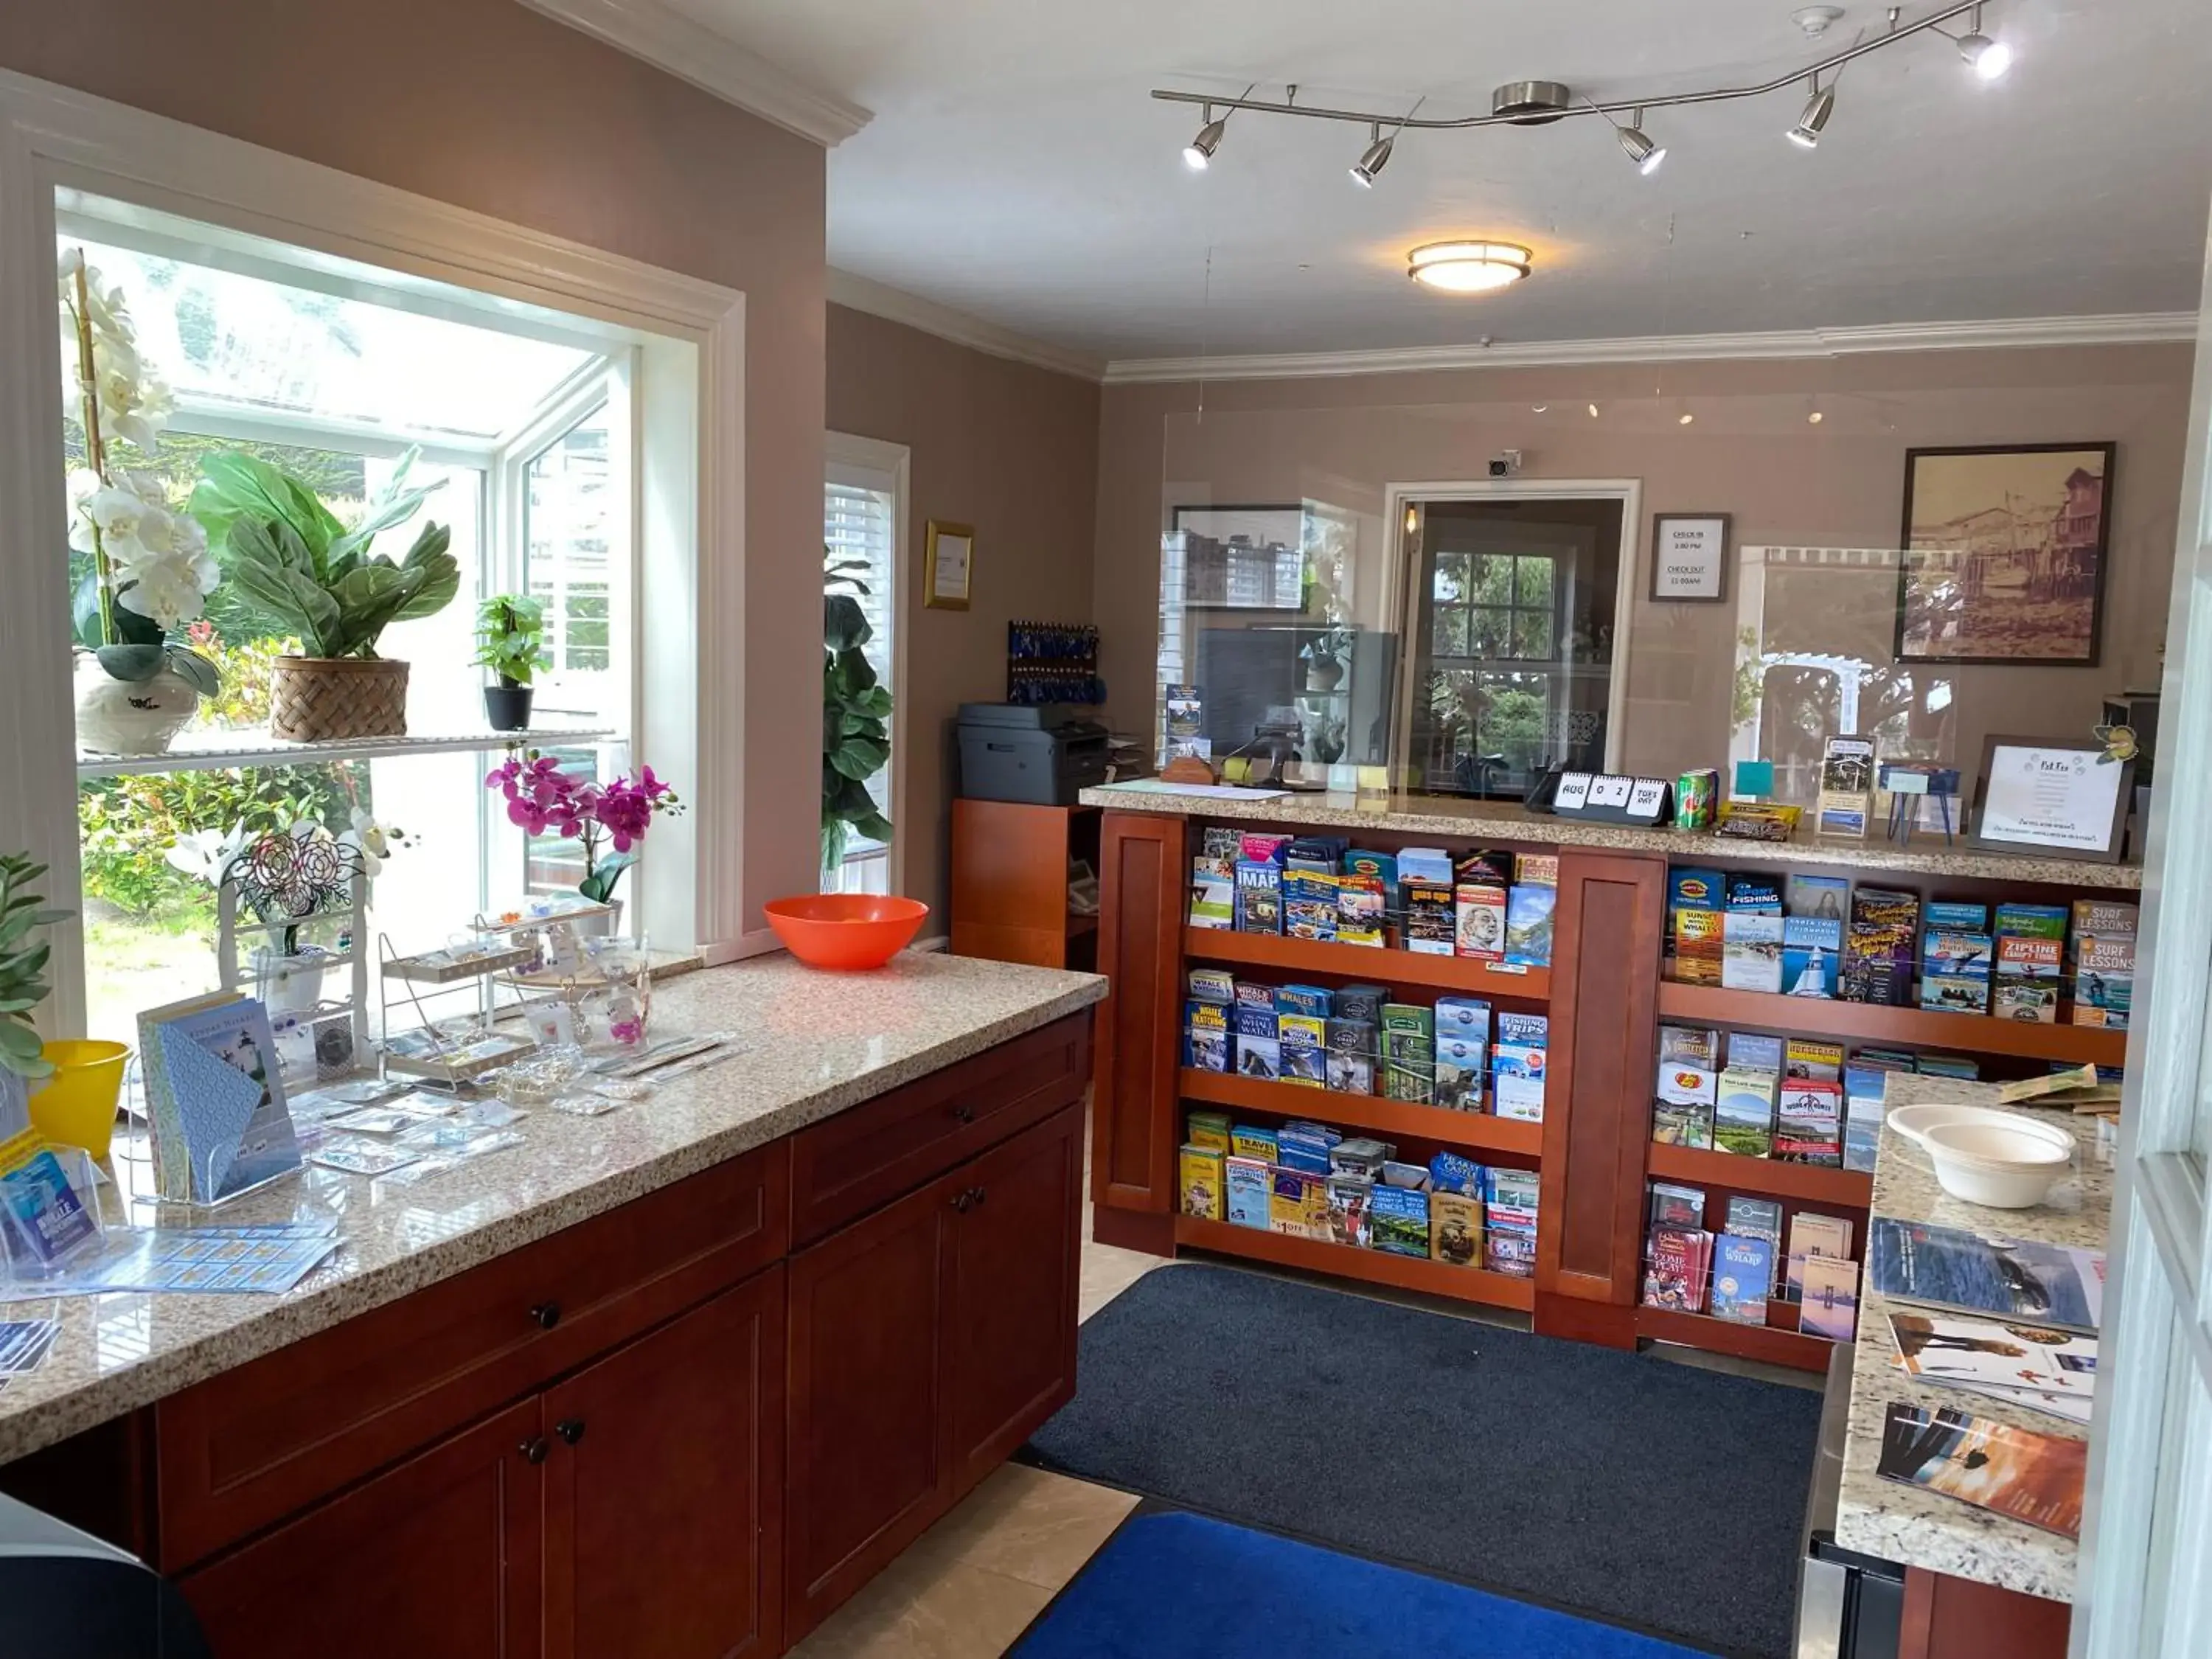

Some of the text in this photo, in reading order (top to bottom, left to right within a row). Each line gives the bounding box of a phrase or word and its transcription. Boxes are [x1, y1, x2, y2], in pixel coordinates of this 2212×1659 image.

[1563, 784, 1584, 795] AUG
[1616, 787, 1623, 796] 2
[1732, 894, 1779, 904] FISHING
[2093, 908, 2124, 919] SURF
[2080, 918, 2132, 931] LESSONS
[2006, 941, 2058, 954] ZIPLINE
[2095, 944, 2126, 956] SURF
[2083, 956, 2135, 970] LESSONS
[1505, 1016, 1545, 1028] FISHING
[1241, 1026, 1275, 1038] WATCH
[1506, 1023, 1547, 1035] TRIPS
[1239, 1138, 1274, 1151] TRAVEL
[1654, 1253, 1686, 1264] COME
